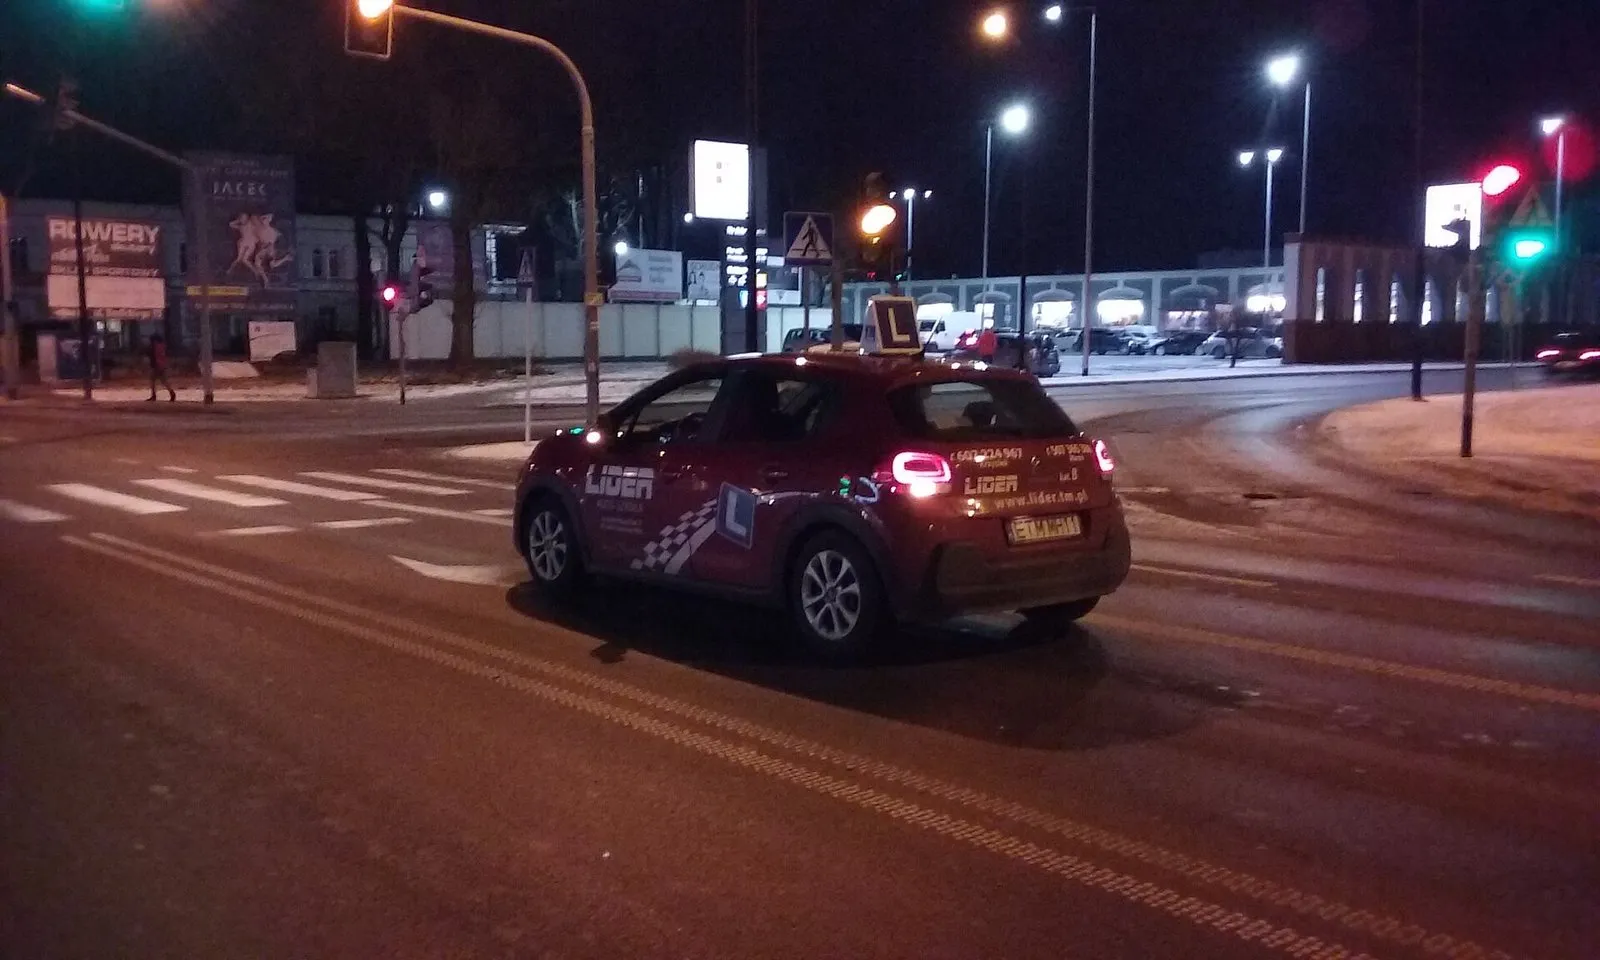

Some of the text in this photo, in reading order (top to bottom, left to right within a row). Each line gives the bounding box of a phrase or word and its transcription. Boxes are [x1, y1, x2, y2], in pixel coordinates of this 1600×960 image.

[49, 219, 160, 244] ROWERY
[887, 307, 911, 343] L
[725, 489, 748, 538] L
[994, 489, 1089, 509] www.lider.tm.pl
